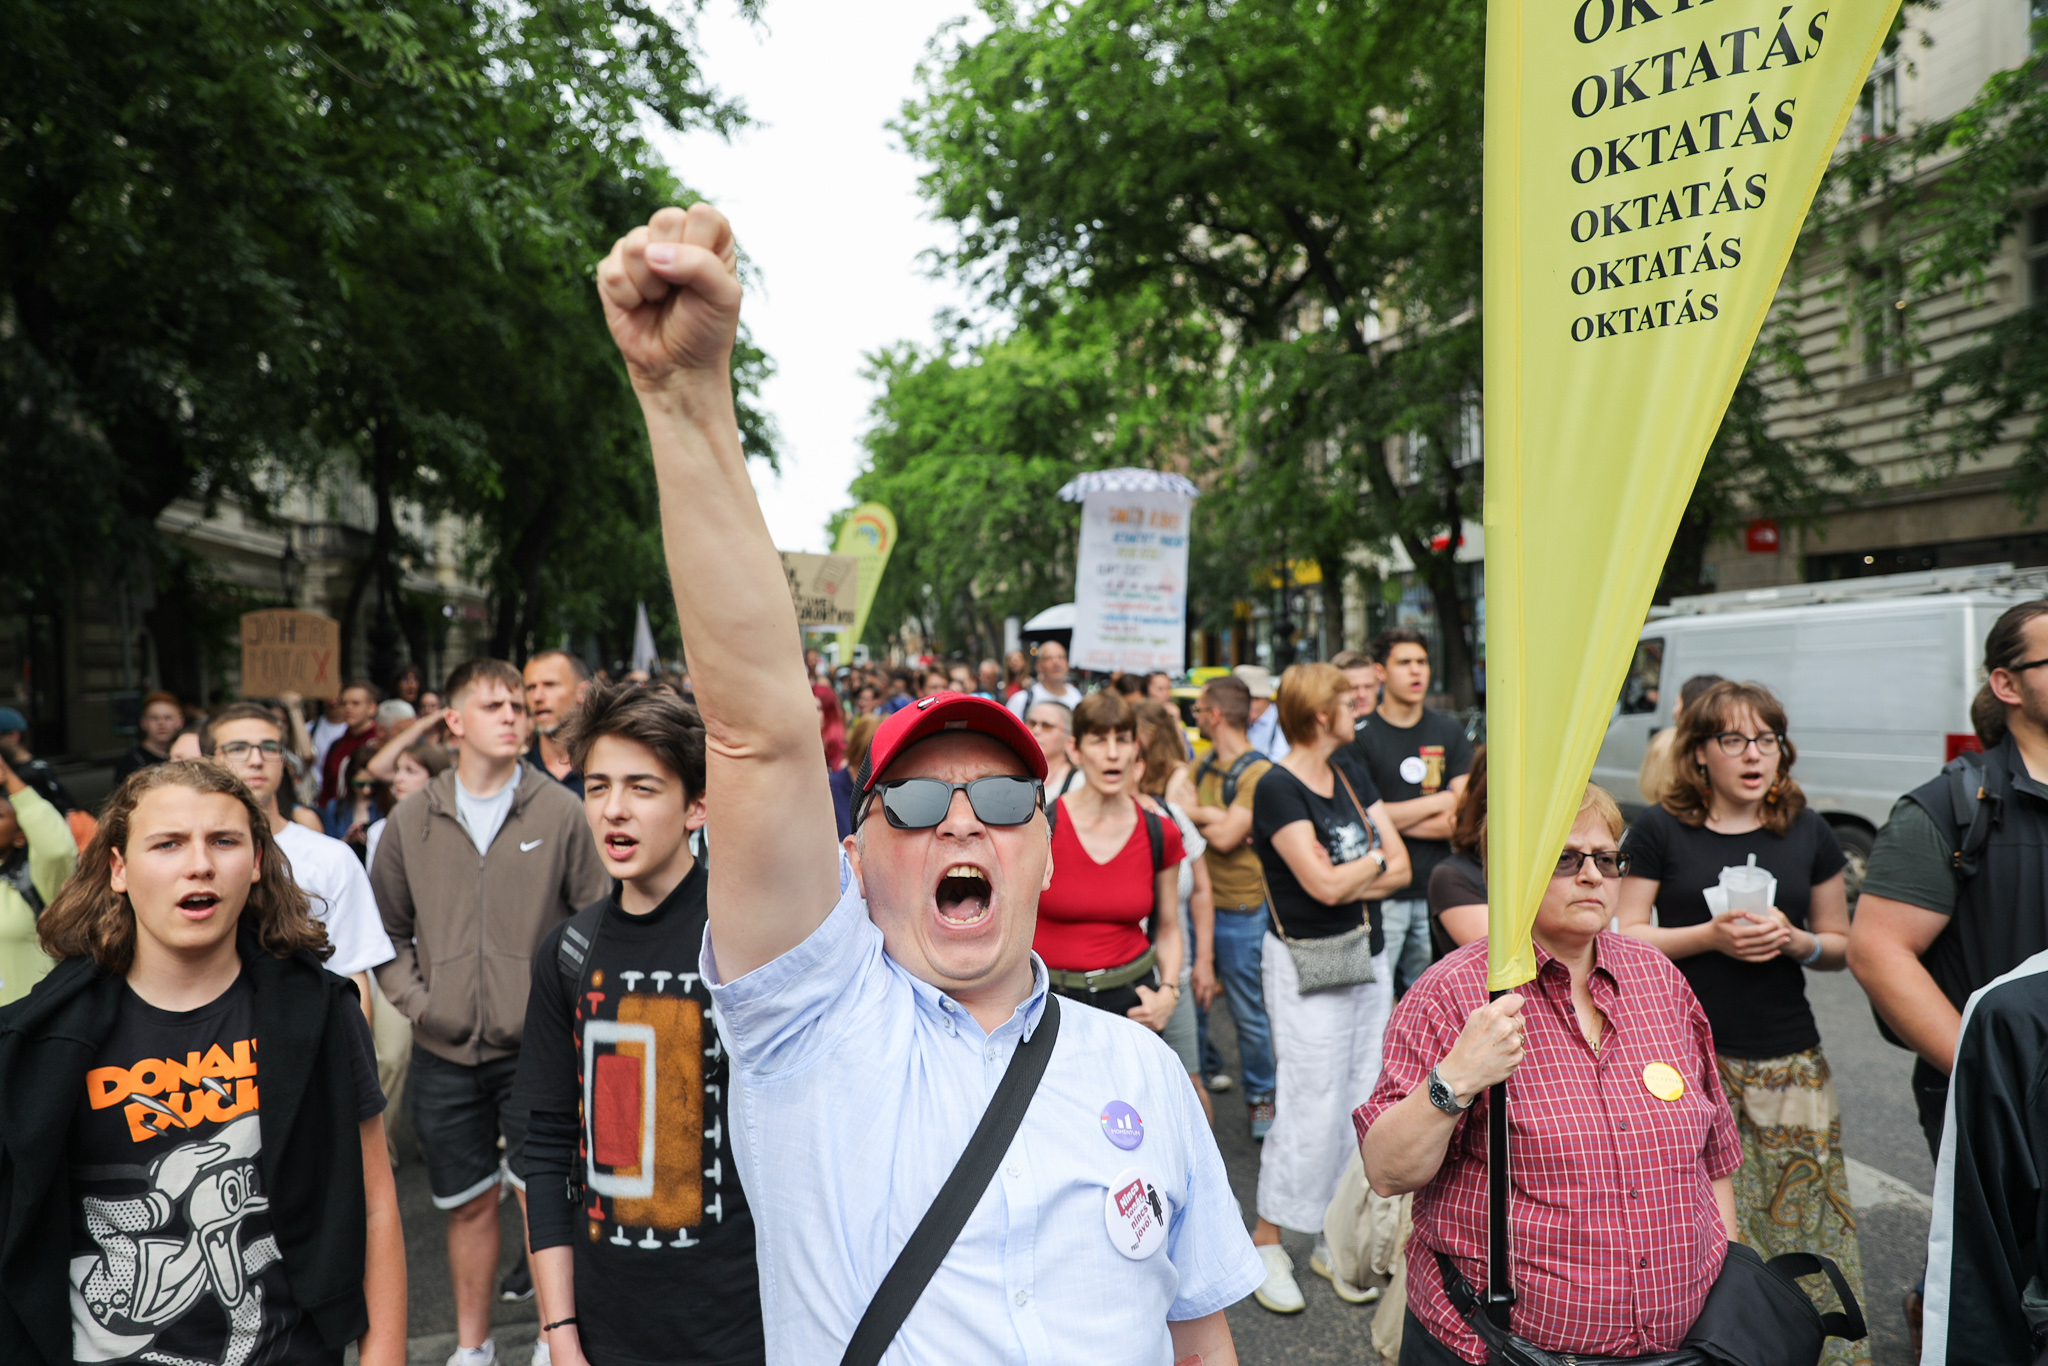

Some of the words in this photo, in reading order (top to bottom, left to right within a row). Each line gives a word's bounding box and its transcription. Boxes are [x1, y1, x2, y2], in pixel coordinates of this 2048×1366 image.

[1571, 5, 1830, 118] OKTATÁS
[1571, 92, 1797, 184] OKTATÁS
[1571, 167, 1767, 243] OKTATÁS
[1571, 232, 1742, 295] OKTATÁS
[1571, 289, 1719, 342] OKTATÁS
[85, 1037, 258, 1110] DONAL
[1110, 1128, 1141, 1137] MOMENTUM
[1119, 1182, 1140, 1210] Nincs
[1131, 1205, 1149, 1230] nincs
